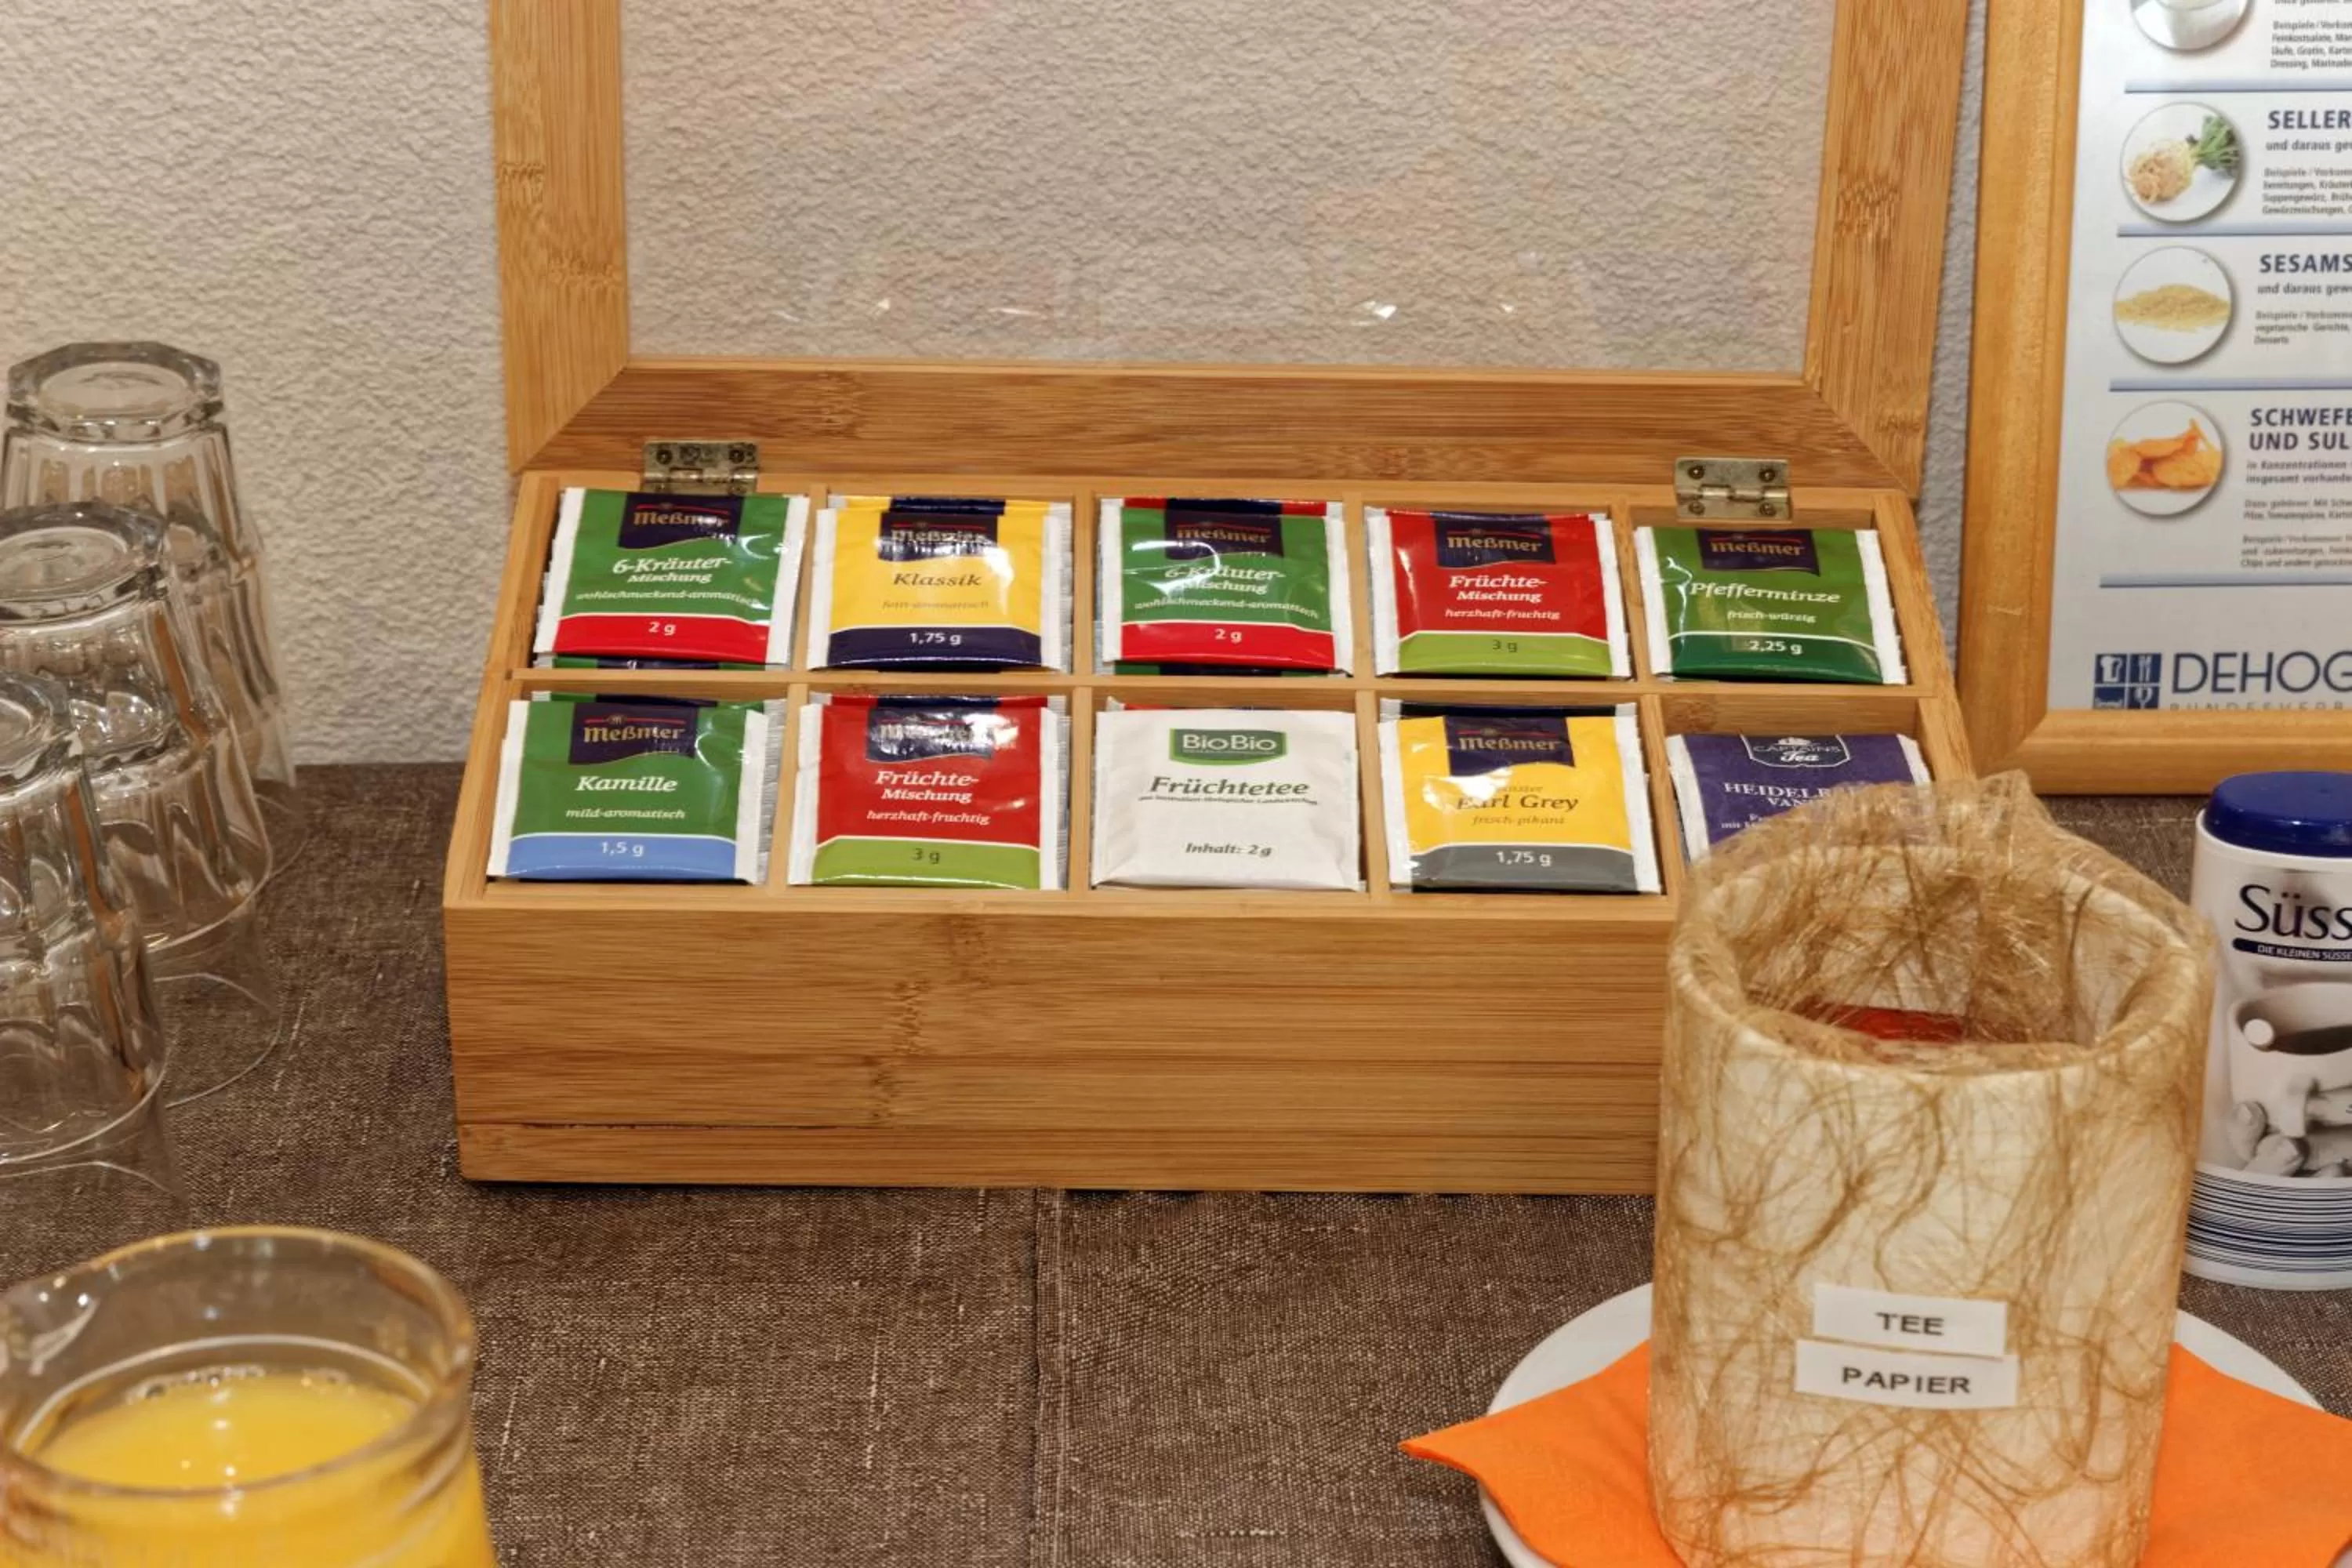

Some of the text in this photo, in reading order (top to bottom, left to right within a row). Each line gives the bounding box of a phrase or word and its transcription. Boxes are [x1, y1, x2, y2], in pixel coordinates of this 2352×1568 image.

[2267, 109, 2351, 130] SELLER
[2265, 140, 2288, 151] und
[2291, 139, 2331, 151] daraus
[2259, 253, 2352, 274] SESAMS
[2257, 281, 2280, 295] und
[2282, 281, 2322, 295] daraus
[2249, 430, 2350, 451] UND SUL
[1447, 535, 1542, 554] Meßmer
[1711, 540, 1805, 557] Meßmer
[612, 556, 734, 575] 6-Kräuter-
[626, 572, 713, 585] Mischung
[893, 573, 982, 586] Klassik
[1184, 579, 1268, 595] ischung
[1448, 574, 1548, 589] Früchte-
[1456, 590, 1542, 604] Mischung
[1689, 582, 1841, 604] Pfefferminze
[1444, 608, 1561, 621] herzhaft-fruchtig
[1727, 610, 1817, 624] frisch-würzig
[648, 622, 677, 636] 2 g
[1215, 629, 1243, 644] 2 g
[909, 632, 963, 646] 1,75 g
[1491, 640, 1518, 653] 3 g
[1749, 641, 1803, 655] 2,25 g
[2172, 650, 2352, 694] DEHOG
[583, 725, 686, 743] Meßmer
[1181, 733, 1278, 752] BioBio
[1457, 737, 1563, 752] Meßmer
[575, 775, 679, 793] Kamille
[875, 770, 980, 787] Früchte-
[1149, 775, 1311, 797] Früchtetee
[880, 788, 973, 804] Mischung
[1520, 794, 1579, 813] Grey
[565, 808, 686, 820] mild-aromatisch
[866, 809, 992, 826] herzhaft-fruchtig
[601, 840, 645, 857] 1,5 g
[912, 847, 941, 865] 3 g
[1185, 841, 1273, 858] Inhalt: 2 g
[1496, 850, 1552, 866] 1,75 g
[2234, 884, 2352, 940] Süss
[1875, 1312, 1945, 1337] TEE
[1841, 1366, 1973, 1396] PAPIER
